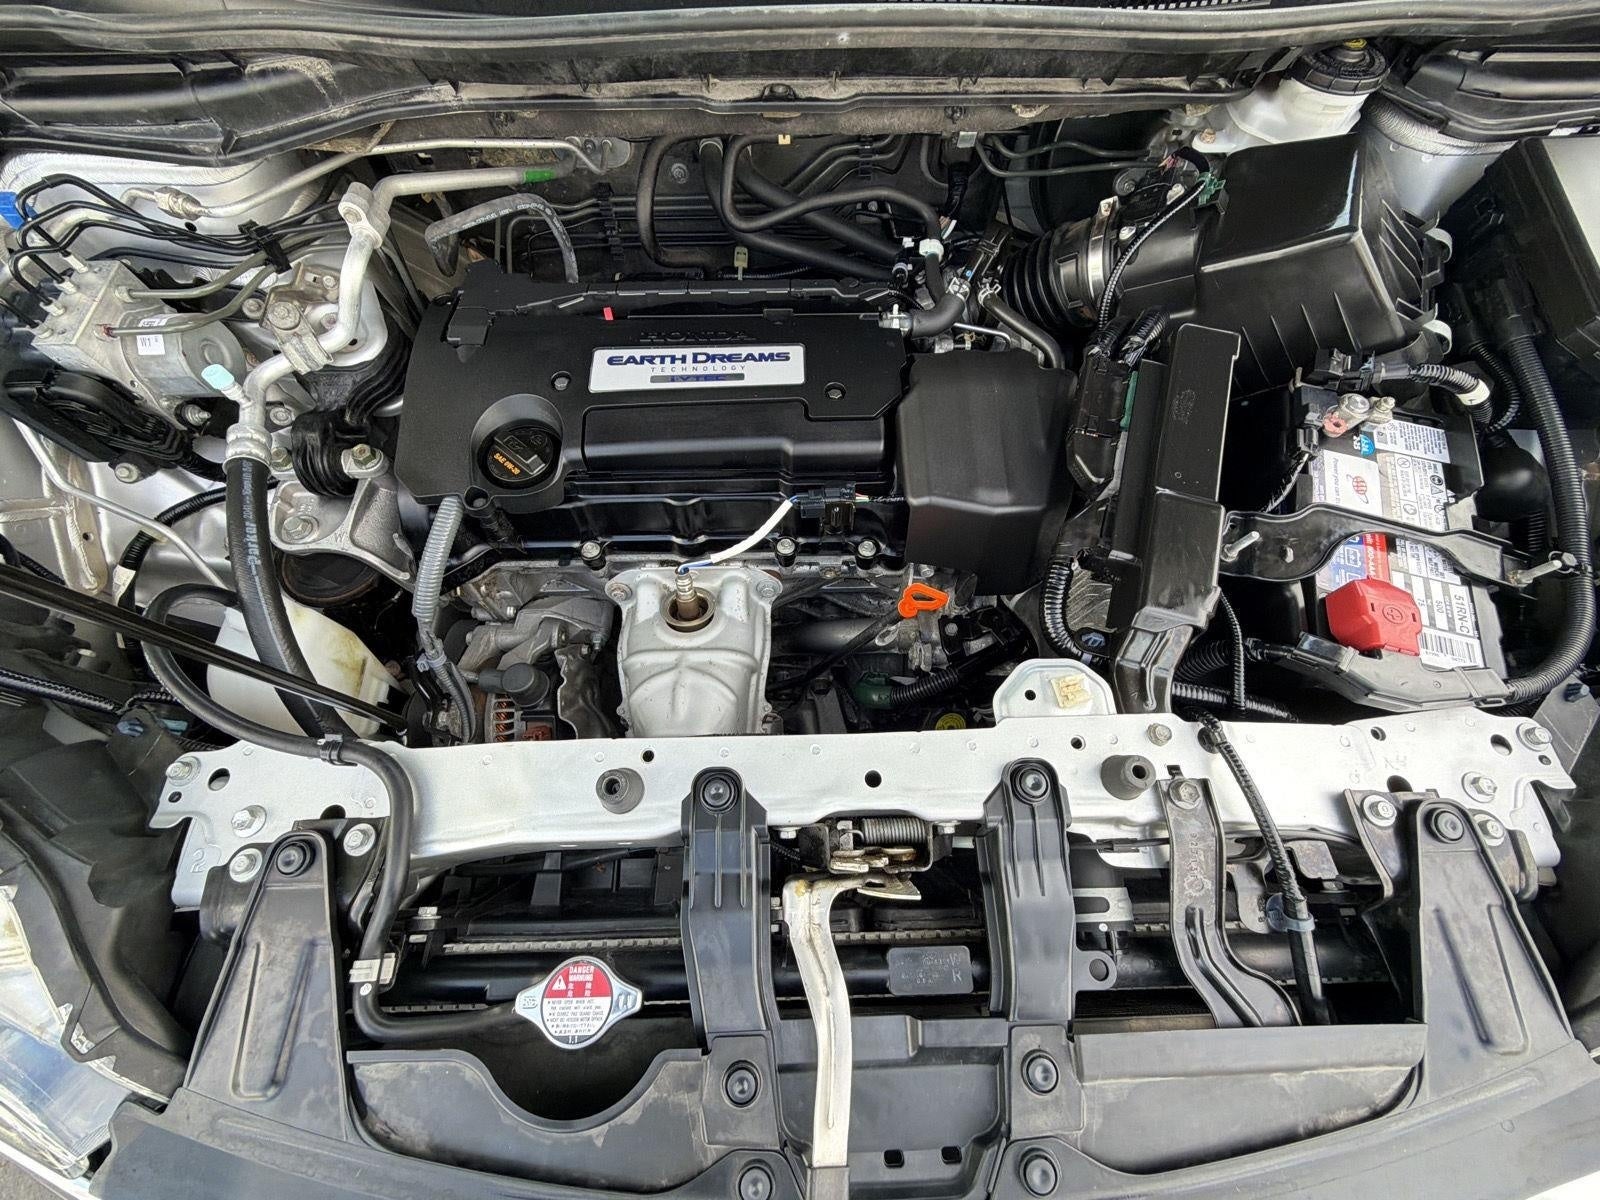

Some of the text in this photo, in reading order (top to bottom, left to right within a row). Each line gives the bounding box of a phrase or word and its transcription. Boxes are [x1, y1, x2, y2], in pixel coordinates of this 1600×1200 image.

[607, 351, 790, 366] EARTH DREAMS
[650, 364, 746, 373] TECHNOLOGY
[245, 521, 261, 566] Parker
[1454, 595, 1470, 634] 51RN-C
[570, 966, 594, 974] DANGER
[569, 974, 593, 982] WARNING
